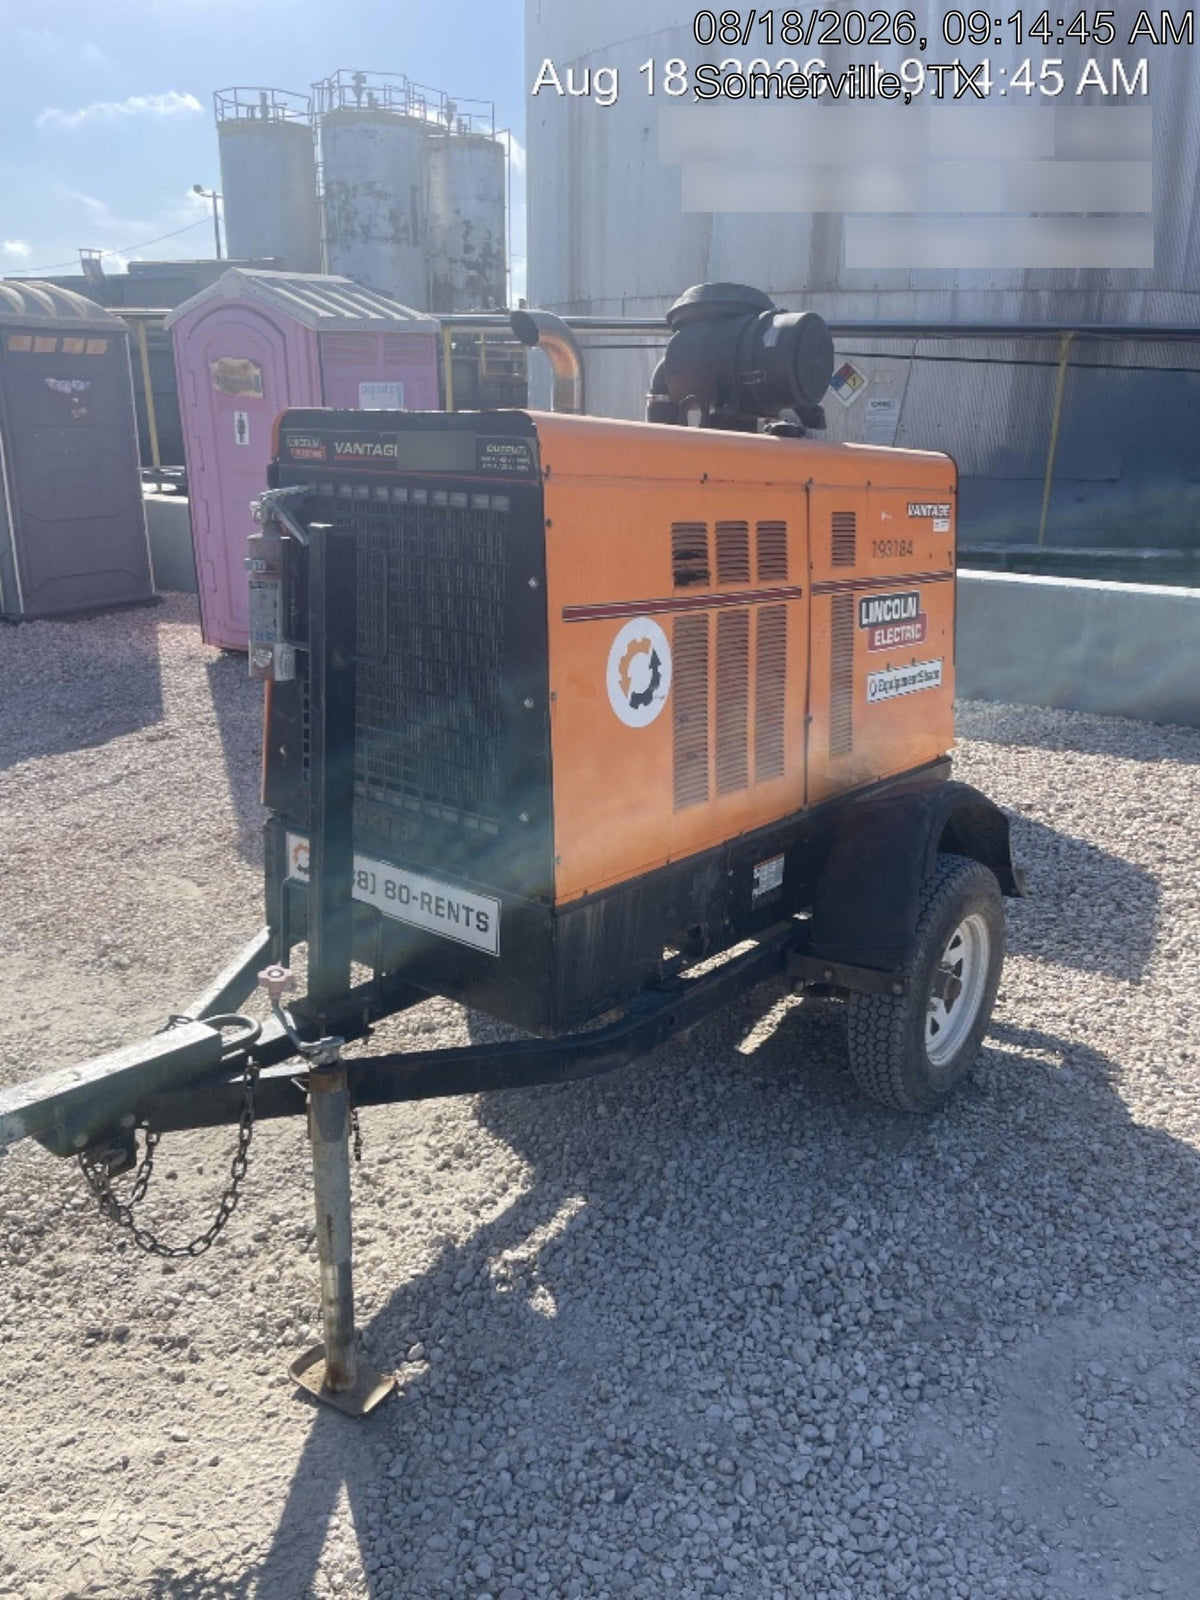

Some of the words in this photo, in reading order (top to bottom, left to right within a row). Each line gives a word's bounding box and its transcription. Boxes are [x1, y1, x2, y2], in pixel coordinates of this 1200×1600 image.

[908, 504, 951, 517] VANTAGE
[872, 540, 914, 558] 193184
[861, 597, 917, 625] LINCOLN
[874, 623, 922, 646] ELECTRIC
[385, 880, 489, 933] 80-RENTS
